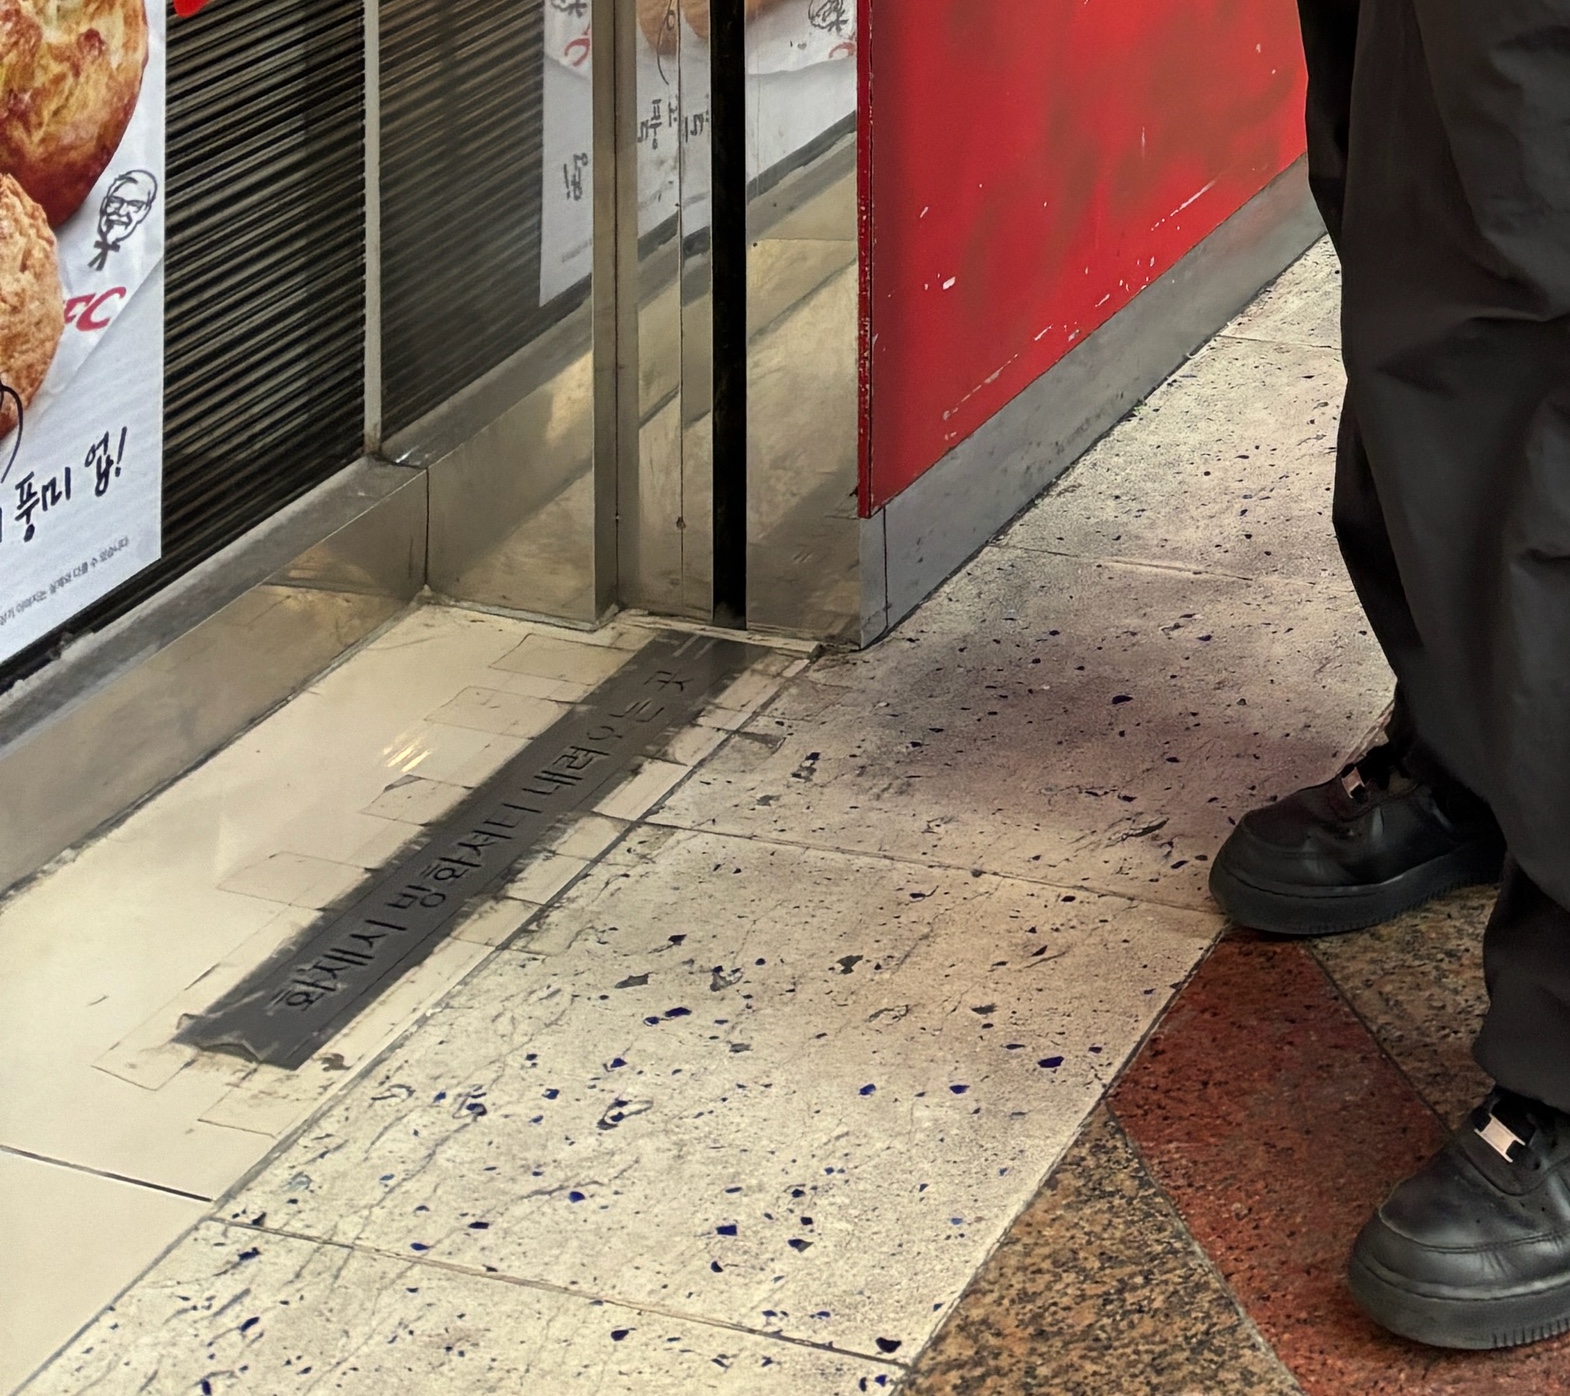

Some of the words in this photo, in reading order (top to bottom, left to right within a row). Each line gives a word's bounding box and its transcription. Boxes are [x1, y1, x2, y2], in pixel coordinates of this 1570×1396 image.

[63, 286, 128, 333] FC
[14, 466, 72, 543] 풍미
[84, 426, 128, 498] 업!
